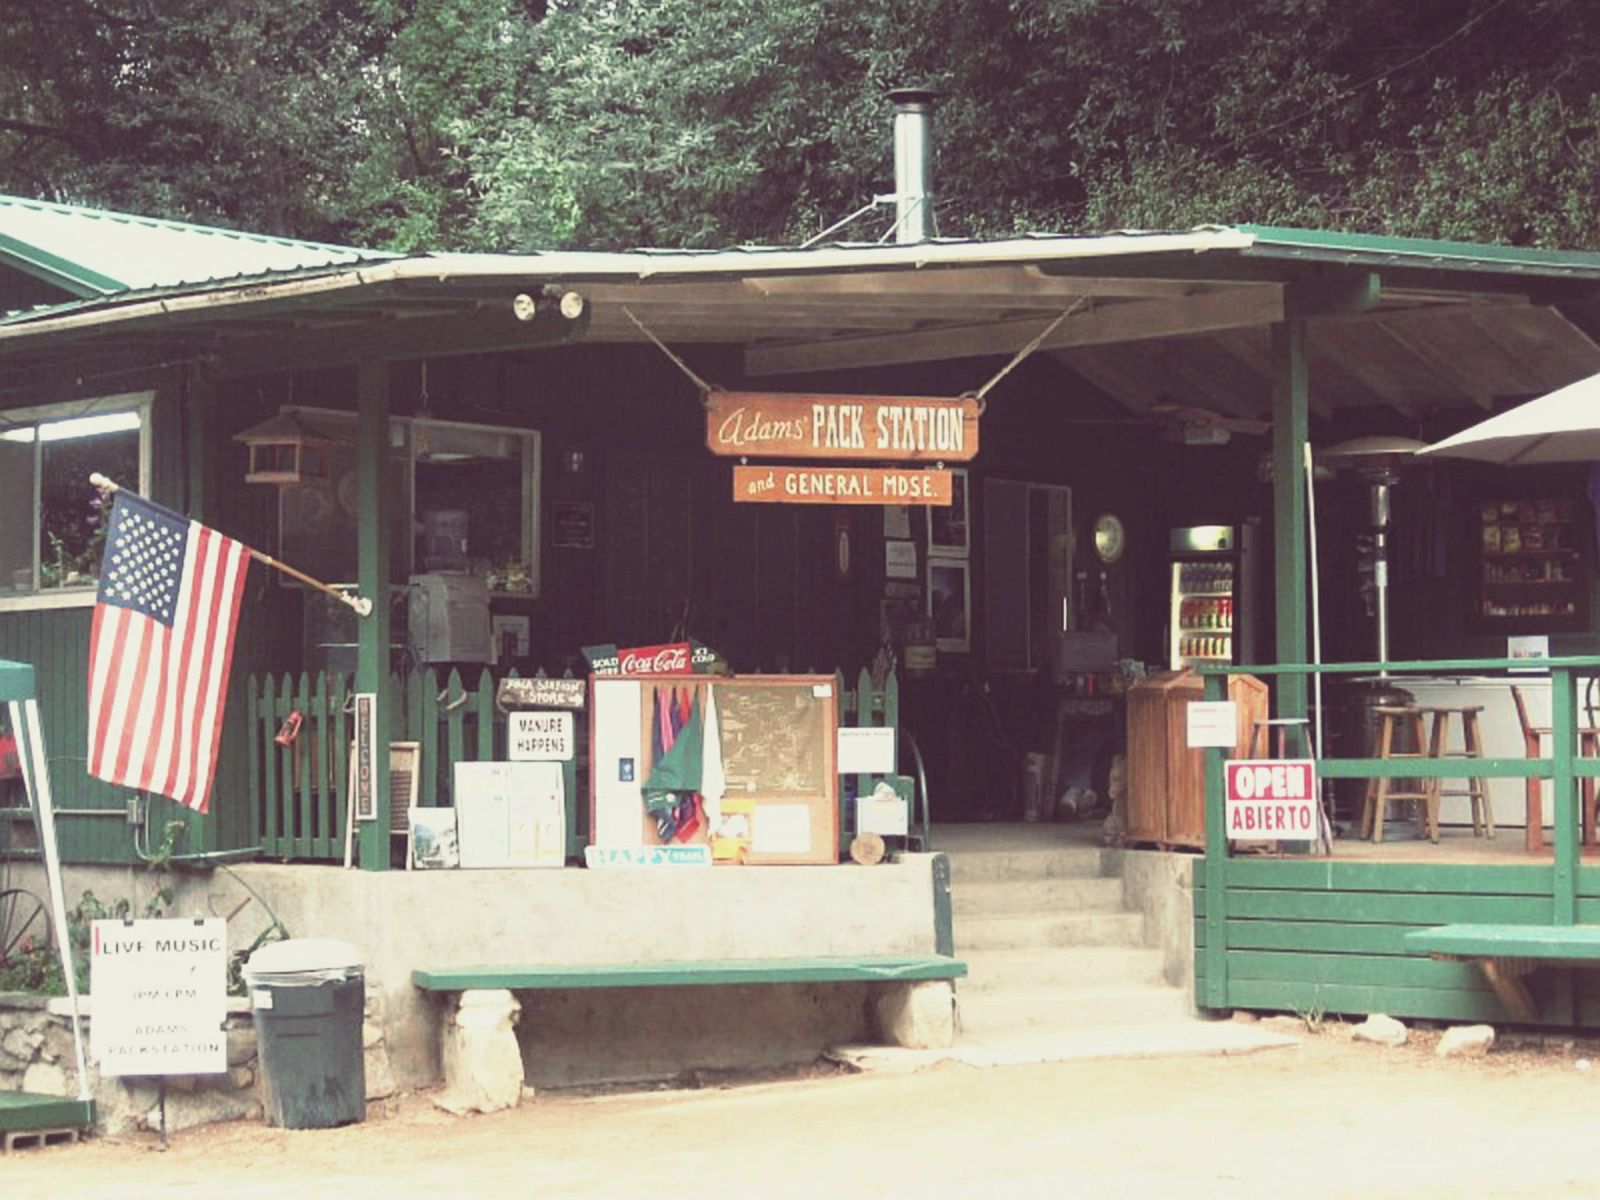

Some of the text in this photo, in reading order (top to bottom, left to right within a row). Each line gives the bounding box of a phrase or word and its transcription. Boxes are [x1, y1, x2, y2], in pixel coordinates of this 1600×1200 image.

[811, 404, 865, 449] PACK
[876, 405, 964, 451] STATION
[747, 472, 939, 497] and GENERAL MDSE.
[592, 656, 619, 668] SOLD
[691, 653, 716, 664] COLD
[519, 718, 563, 733] MANURE
[517, 738, 565, 752] HAPPENS
[1235, 765, 1305, 799] OPEN
[1232, 804, 1311, 830] ABIERTO
[103, 938, 222, 955] LIVE MUSIC
[135, 1024, 189, 1035] ADAMS
